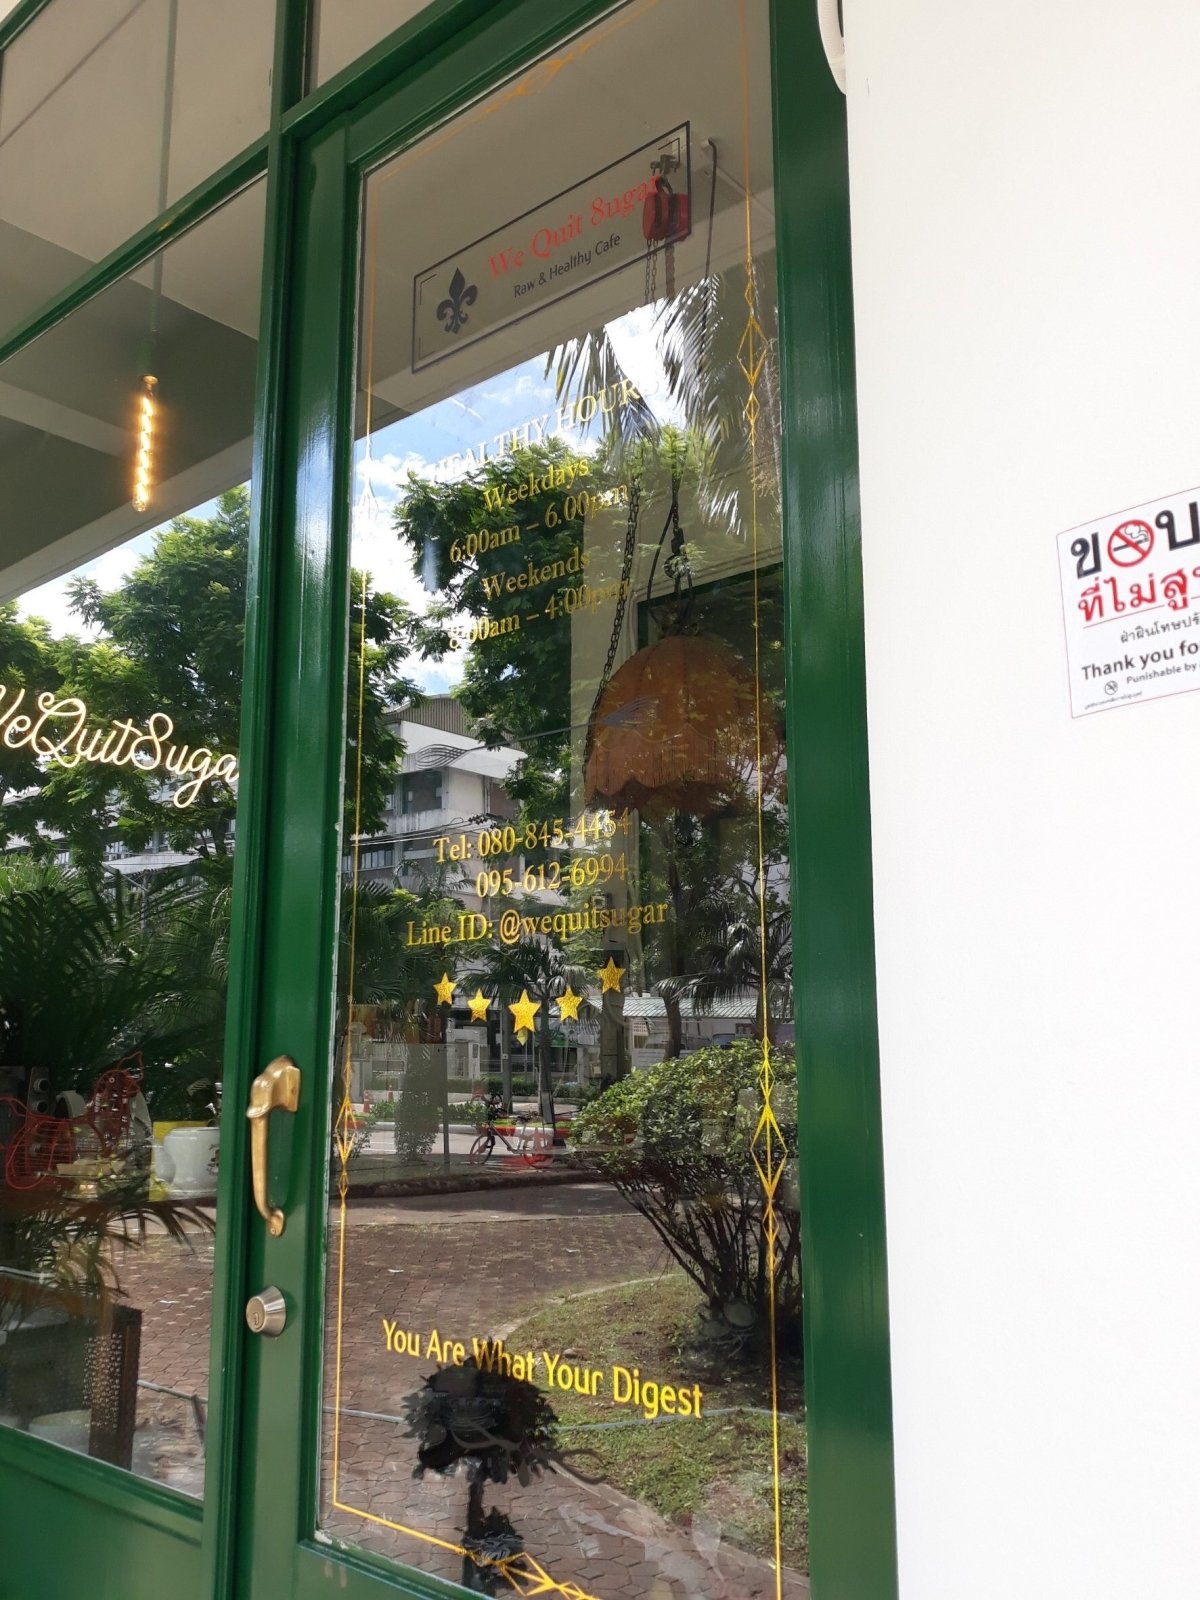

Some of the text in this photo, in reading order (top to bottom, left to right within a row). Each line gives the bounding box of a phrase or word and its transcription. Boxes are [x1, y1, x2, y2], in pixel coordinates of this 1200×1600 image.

[488, 248, 525, 282] We
[530, 212, 584, 261] Quit
[513, 233, 621, 299] Raw & Healthy Cafe
[482, 458, 590, 514] Weekdays
[449, 522, 522, 564] 6:00am
[481, 546, 591, 602] Weekends
[1078, 565, 1200, 622] ที่ไม่สู
[448, 612, 522, 650] 800am
[1081, 640, 1200, 681] Thank you fo
[1126, 662, 1197, 684] Punishable by
[433, 806, 631, 864] Tel: 080-845-4454
[476, 852, 630, 898] 095-612-6994
[406, 902, 670, 946] Line ID: @wequitsugar
[382, 1319, 704, 1420] You Are What Your Digest
